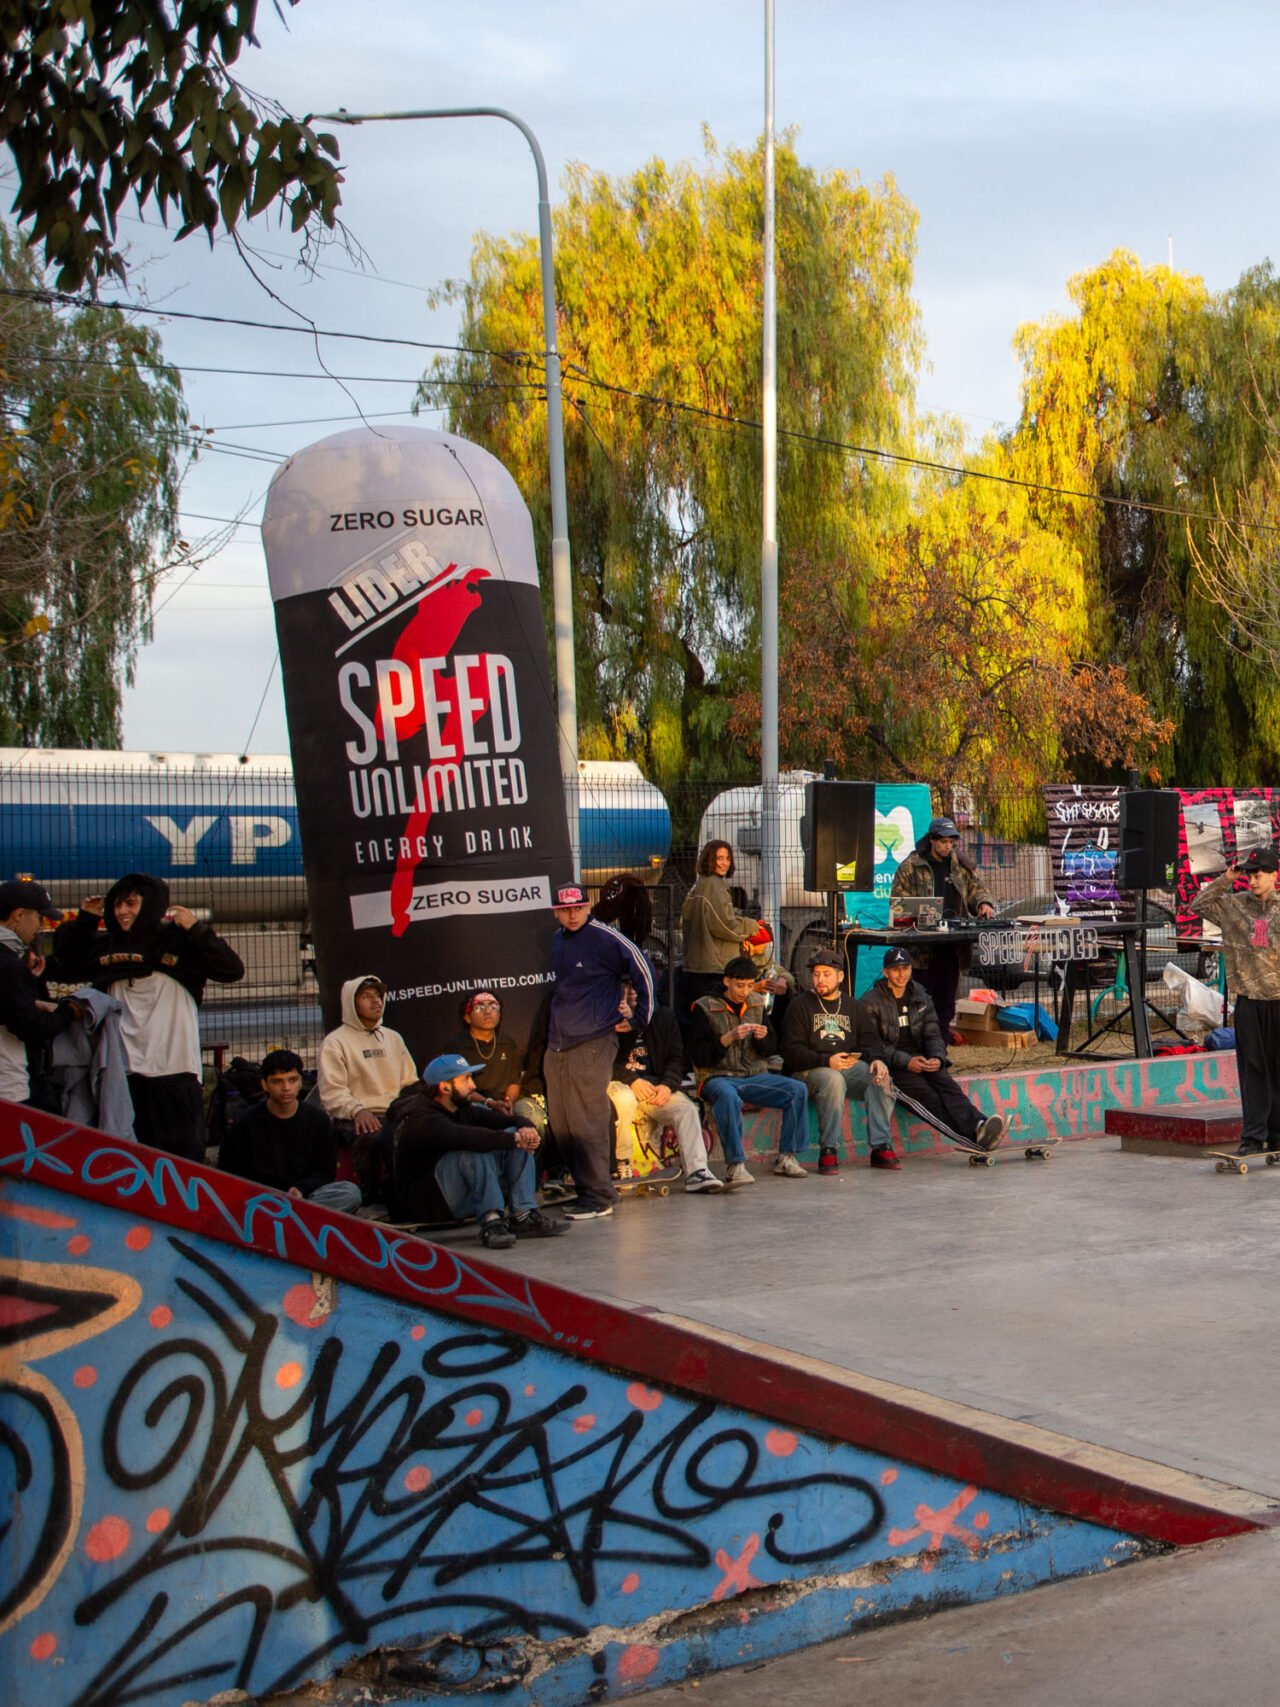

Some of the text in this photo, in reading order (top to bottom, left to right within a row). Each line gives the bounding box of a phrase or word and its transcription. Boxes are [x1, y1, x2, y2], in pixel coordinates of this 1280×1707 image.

[330, 508, 485, 532] ZERO SUGAR
[327, 540, 445, 632] LIDER
[337, 653, 522, 766] SPEED
[348, 757, 529, 819] UNLIMITED
[355, 826, 533, 864] ENERGY DRINK
[413, 885, 542, 911] ZERO SUGAR
[979, 931, 1024, 966] SPEED
